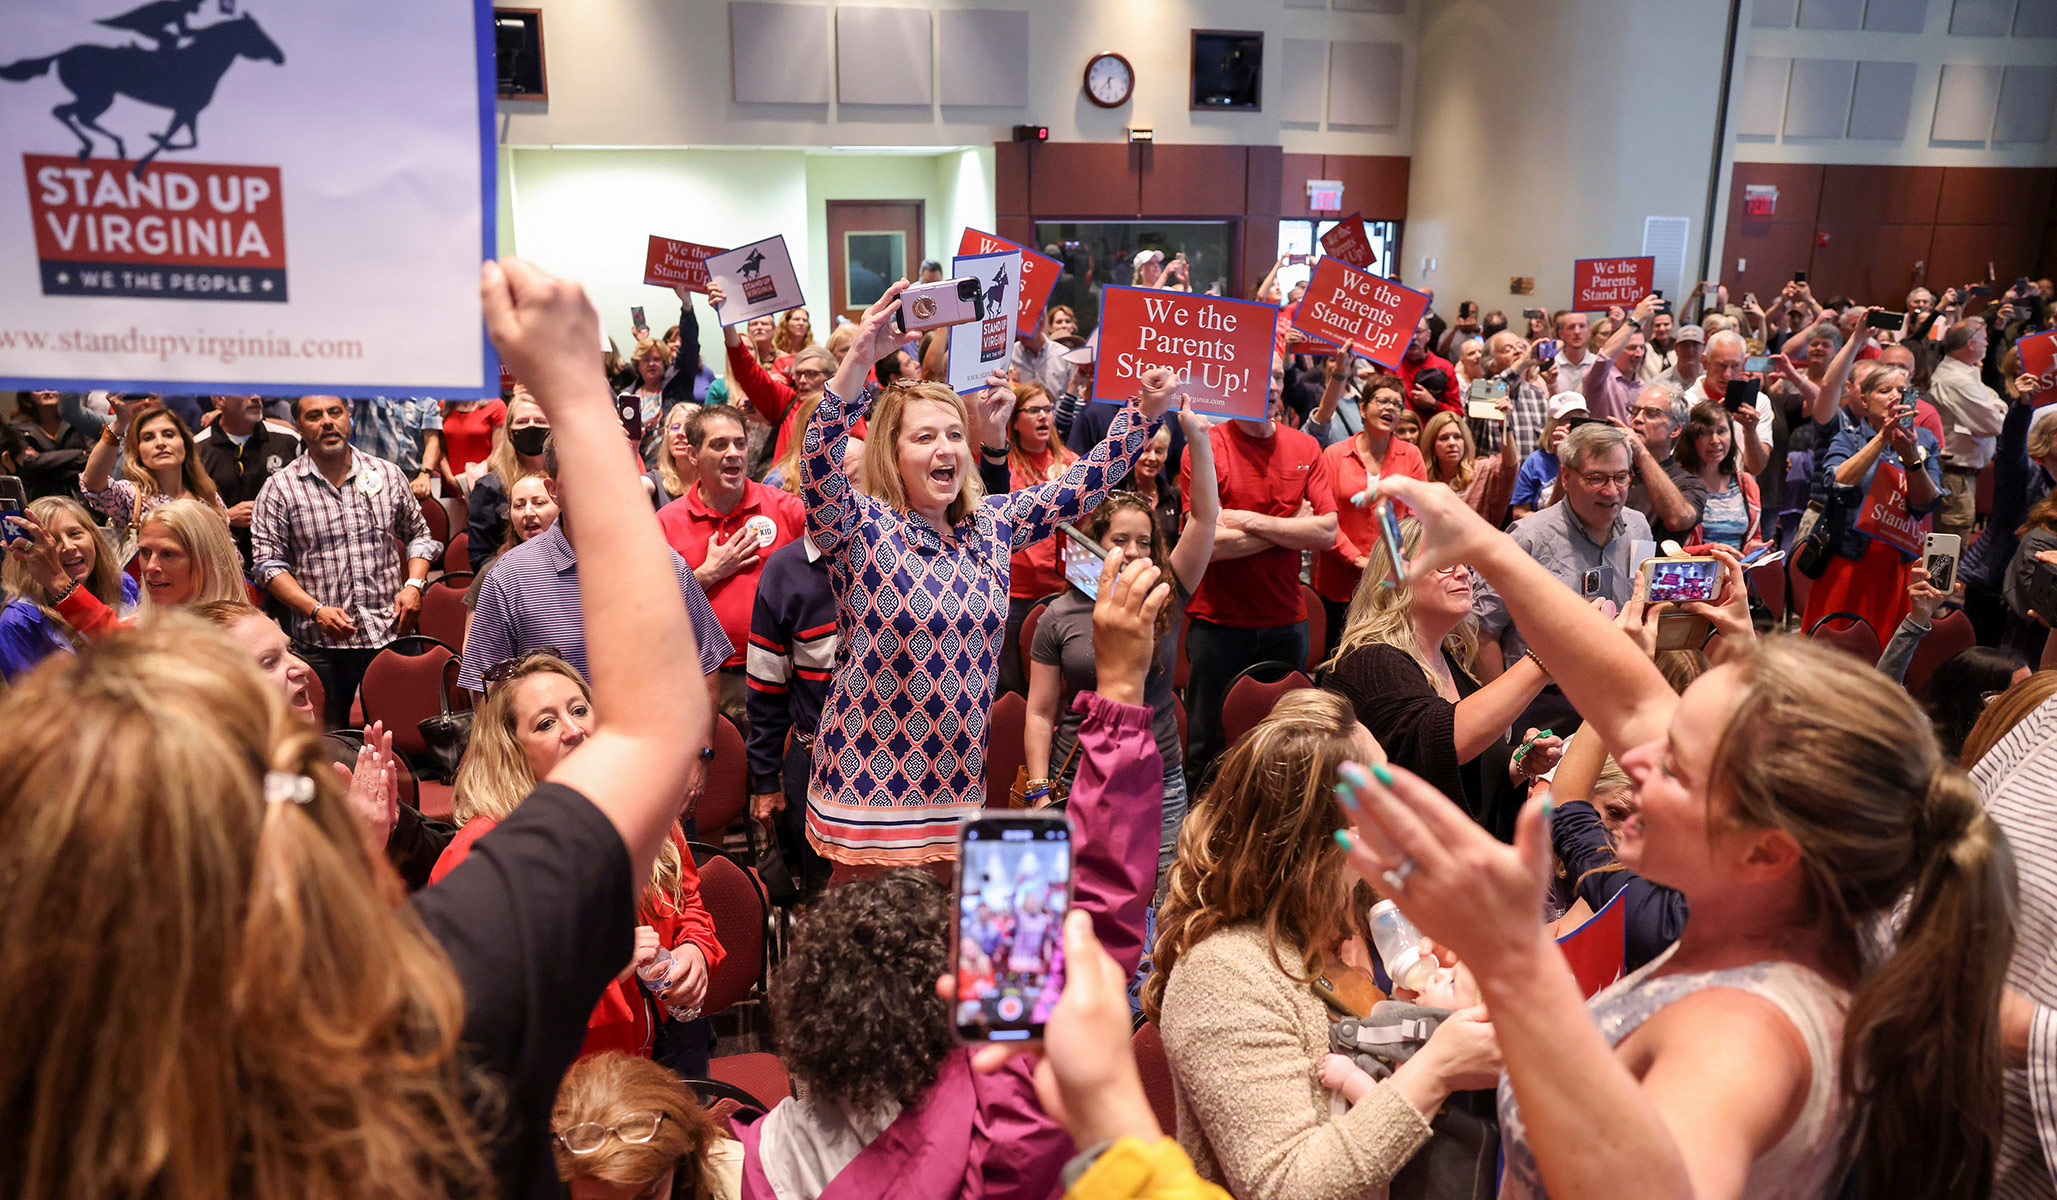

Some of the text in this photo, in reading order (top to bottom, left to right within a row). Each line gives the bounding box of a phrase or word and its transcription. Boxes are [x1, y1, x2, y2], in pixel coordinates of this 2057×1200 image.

[36, 165, 271, 214] STAND UP
[45, 210, 271, 258] VIRGINIA
[664, 253, 706, 271] Parent
[667, 241, 688, 256] We
[653, 263, 690, 281] Stand
[1593, 260, 1638, 274] We the
[79, 270, 252, 294] WE THE PEOPLE
[1343, 269, 1401, 308] We the
[1582, 286, 1644, 303] Stand Up!
[1592, 275, 1637, 288] Parents
[1143, 297, 1238, 333] We the
[1330, 287, 1394, 328] Parents
[983, 320, 1001, 336] STAND
[1311, 301, 1363, 335] Stand
[1364, 321, 1399, 350] Up!
[983, 332, 1006, 349] VIRGINIA
[1137, 325, 1236, 362] Parents
[1201, 362, 1250, 398] Up!
[1871, 503, 1911, 533] Stand
